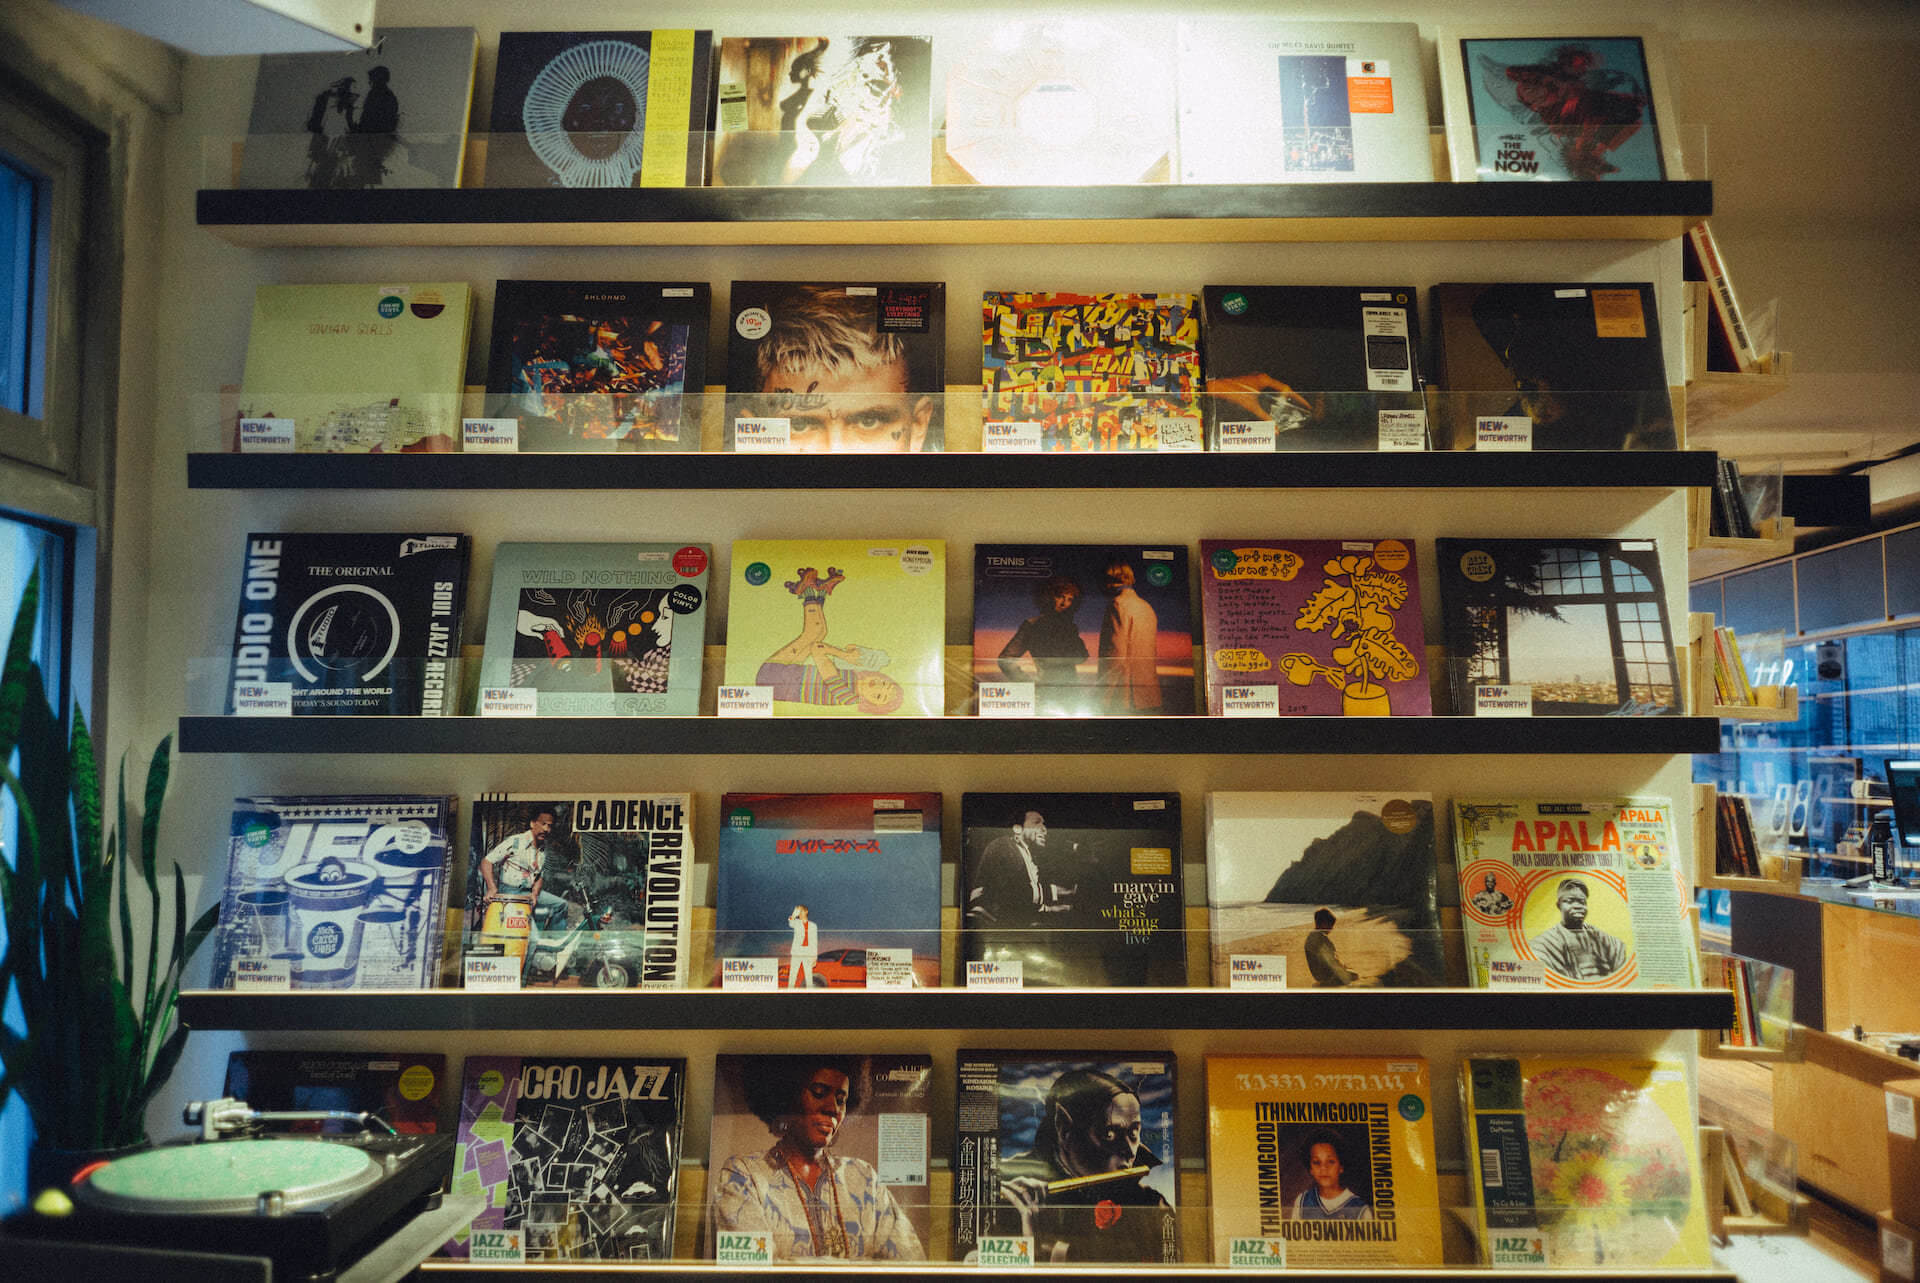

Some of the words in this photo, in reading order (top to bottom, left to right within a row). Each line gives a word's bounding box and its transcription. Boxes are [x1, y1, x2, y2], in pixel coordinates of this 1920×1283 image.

[1497, 150, 1536, 160] NOW
[1495, 161, 1539, 173] NOW
[357, 322, 393, 336] GIRLS
[242, 423, 272, 433] NEW+
[465, 423, 495, 433] NEW+
[737, 423, 766, 433] NEW+
[988, 426, 1018, 435] NEW+
[1222, 424, 1251, 434] NEW+
[1479, 421, 1508, 432] NEW+
[242, 437, 290, 445] NOTEWORTHY
[465, 437, 514, 445] NOTEWORTHY
[737, 437, 786, 445] NOTEWORTHY
[988, 438, 1037, 446] NOTEWORTHY
[1222, 437, 1272, 445] NOTEWORTHY
[1478, 434, 1528, 442] NOTEWORTHY
[986, 556, 1025, 566] TENNIS
[246, 540, 282, 601] ONE
[308, 566, 333, 576] THE
[335, 566, 395, 576] ORIGINAL
[522, 570, 576, 585] WILD
[581, 570, 677, 585] NOTHING
[431, 582, 453, 618] SOUL
[673, 590, 698, 604] COLOR
[672, 597, 695, 609] VINYL
[429, 622, 450, 657] JAZZ
[234, 612, 274, 686] UDIO
[1219, 651, 1259, 660] MTV
[239, 686, 269, 697] NEW+
[309, 688, 343, 696] AROUND
[345, 687, 361, 695] THE
[363, 687, 393, 695] WORLD
[484, 690, 514, 700] NEW+
[720, 688, 750, 698] NEW+
[982, 687, 1011, 697] NEW+
[1225, 688, 1255, 699] NEW+
[1478, 687, 1508, 697] NEW+
[239, 701, 288, 709] NOTEWORTHY
[484, 702, 533, 711] NOTEWORTHY
[624, 697, 667, 713] GAS
[720, 702, 770, 710] NOTEWORTHY
[982, 701, 1031, 709] NOTEWORTHY
[1225, 701, 1275, 709] NOTEWORTHY
[1478, 700, 1528, 708] NOTEWORTHY
[575, 800, 684, 831] CADENCE
[1620, 809, 1663, 823] APALA
[1512, 820, 1622, 852] APALA
[1634, 833, 1656, 842] APALA
[1512, 853, 1533, 867] APALA
[1534, 853, 1560, 867] GROUPS
[1562, 853, 1569, 867] IN
[1571, 853, 1597, 867] NIGERIA
[1112, 880, 1175, 894] marvin
[1123, 892, 1160, 909] gaye
[643, 832, 683, 981] REVOLUTION
[1119, 916, 1160, 932] going
[1132, 926, 1152, 936] on
[1125, 931, 1150, 945] live
[238, 961, 268, 972] NEW+
[468, 961, 497, 973] NEW+
[725, 961, 754, 972] NEW+
[969, 963, 999, 974] NEW+
[1232, 960, 1262, 970] NEW+
[1492, 961, 1522, 972] NEW+
[238, 974, 286, 983] NOTEWORTHY
[468, 974, 517, 983] NOTEWORTHY
[725, 974, 774, 983] NOTEWORTHY
[969, 976, 1019, 985] NOTEWORTHY
[1232, 973, 1282, 982] NOTEWORTHY
[1492, 975, 1541, 984] NOTEWORTHY
[586, 1065, 671, 1100] JAZZ
[1236, 1073, 1307, 1091] KASSA
[1313, 1073, 1405, 1091] OVERALL
[1255, 1102, 1369, 1122] ITHINKIMGOOD
[1368, 1103, 1396, 1221] ITHINKIMGOOD
[1256, 1122, 1281, 1236] THINKIMGOOD
[1281, 1221, 1397, 1241] ITHINKIMGOOD
[472, 1234, 505, 1248] JAZZ
[719, 1236, 751, 1250] JAZZ
[981, 1239, 1014, 1254] JAZZ
[1495, 1238, 1528, 1252] JAZZ
[1232, 1240, 1265, 1255] JAZZ
[472, 1248, 521, 1259] SELECTION
[719, 1250, 768, 1261] SELECTION
[1495, 1253, 1544, 1263] SELECTION
[980, 1254, 1030, 1265] SELECTION
[1232, 1255, 1282, 1266] SELECTION
